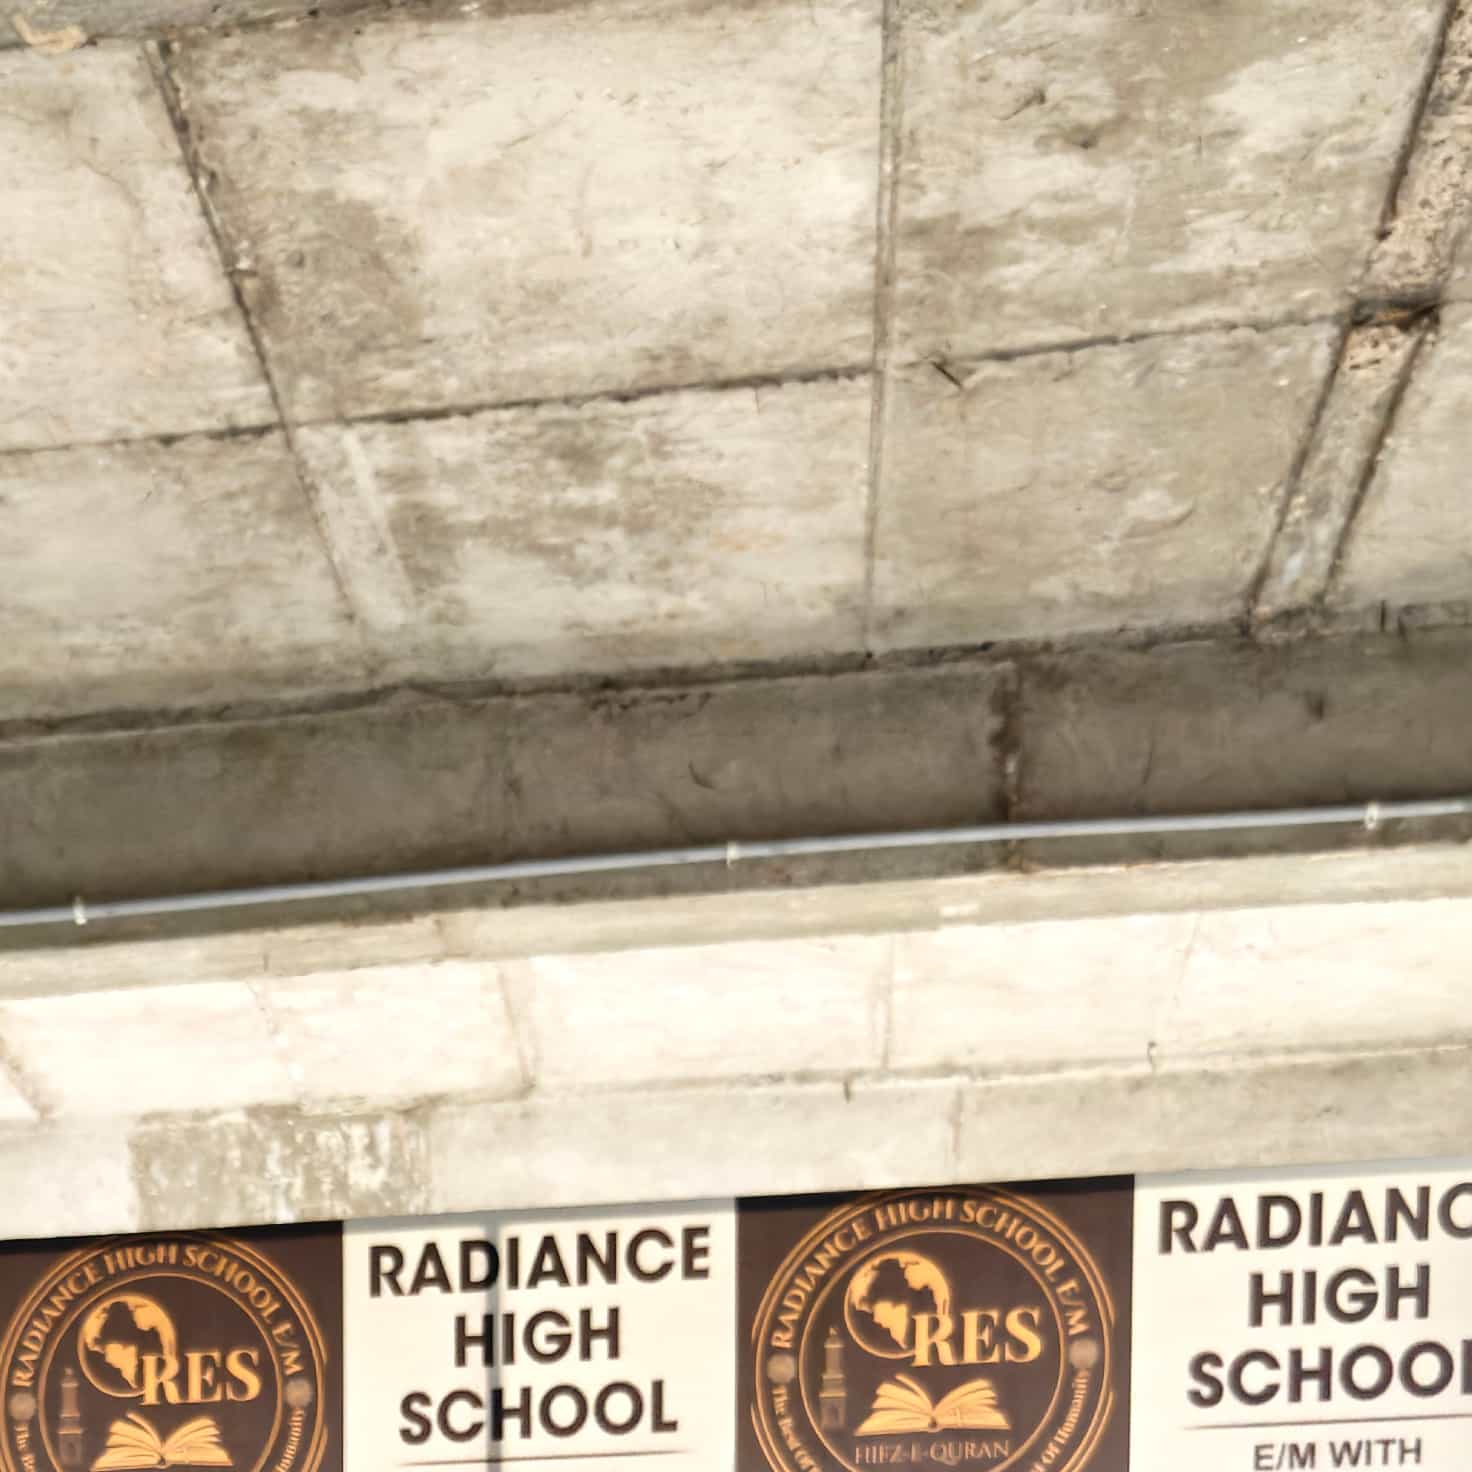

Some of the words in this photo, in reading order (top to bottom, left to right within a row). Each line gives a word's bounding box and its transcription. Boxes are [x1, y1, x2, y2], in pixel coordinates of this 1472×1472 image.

[370, 1226, 709, 1297] RADIANCE
[769, 1216, 872, 1349] RADIANCE
[871, 1198, 953, 1229] HIGH
[959, 1199, 1070, 1281] SCHOOL
[11, 1261, 102, 1388] RADIANCE
[101, 1243, 176, 1273] HIGH
[182, 1244, 284, 1323] SCHOOL
[1250, 1264, 1430, 1327] HIGH
[455, 1307, 619, 1367] HIGH
[910, 1308, 1042, 1367] RES
[139, 1348, 260, 1405] RES
[400, 1380, 677, 1444] SCHOOL
[1254, 1443, 1316, 1470] E/M
[1329, 1438, 1421, 1467] WITH
